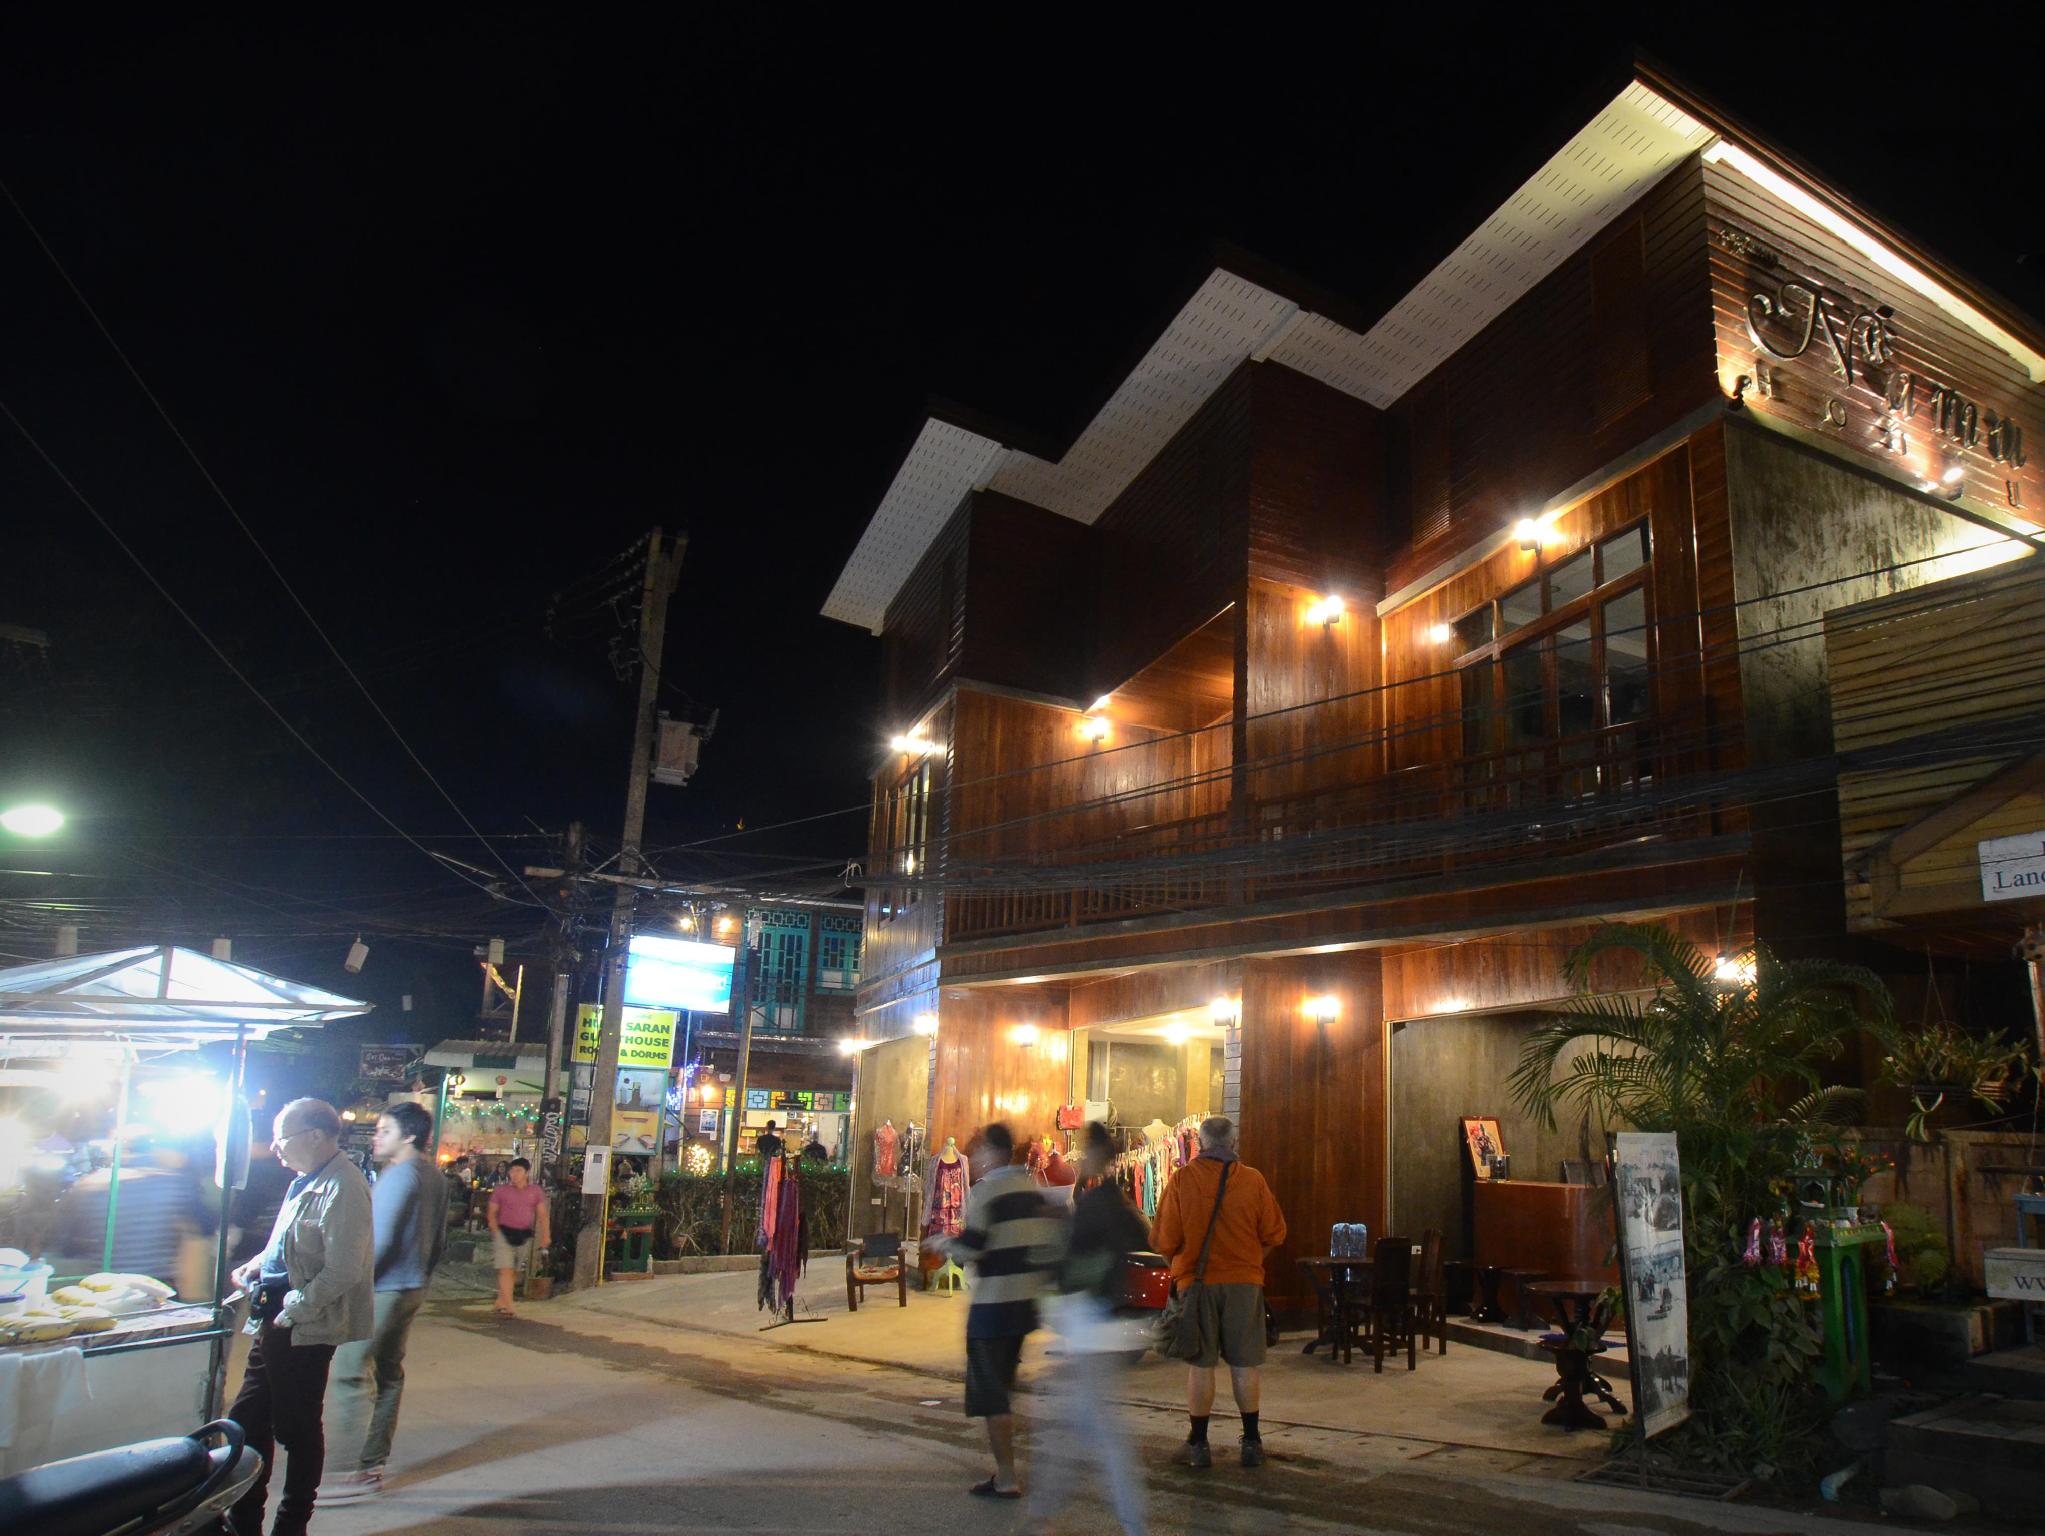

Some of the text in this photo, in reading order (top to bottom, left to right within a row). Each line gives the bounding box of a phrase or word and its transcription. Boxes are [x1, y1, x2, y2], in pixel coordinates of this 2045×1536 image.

[625, 1022, 670, 1034] SARAN
[620, 1049, 628, 1057] &
[630, 1050, 667, 1060] DORMS
